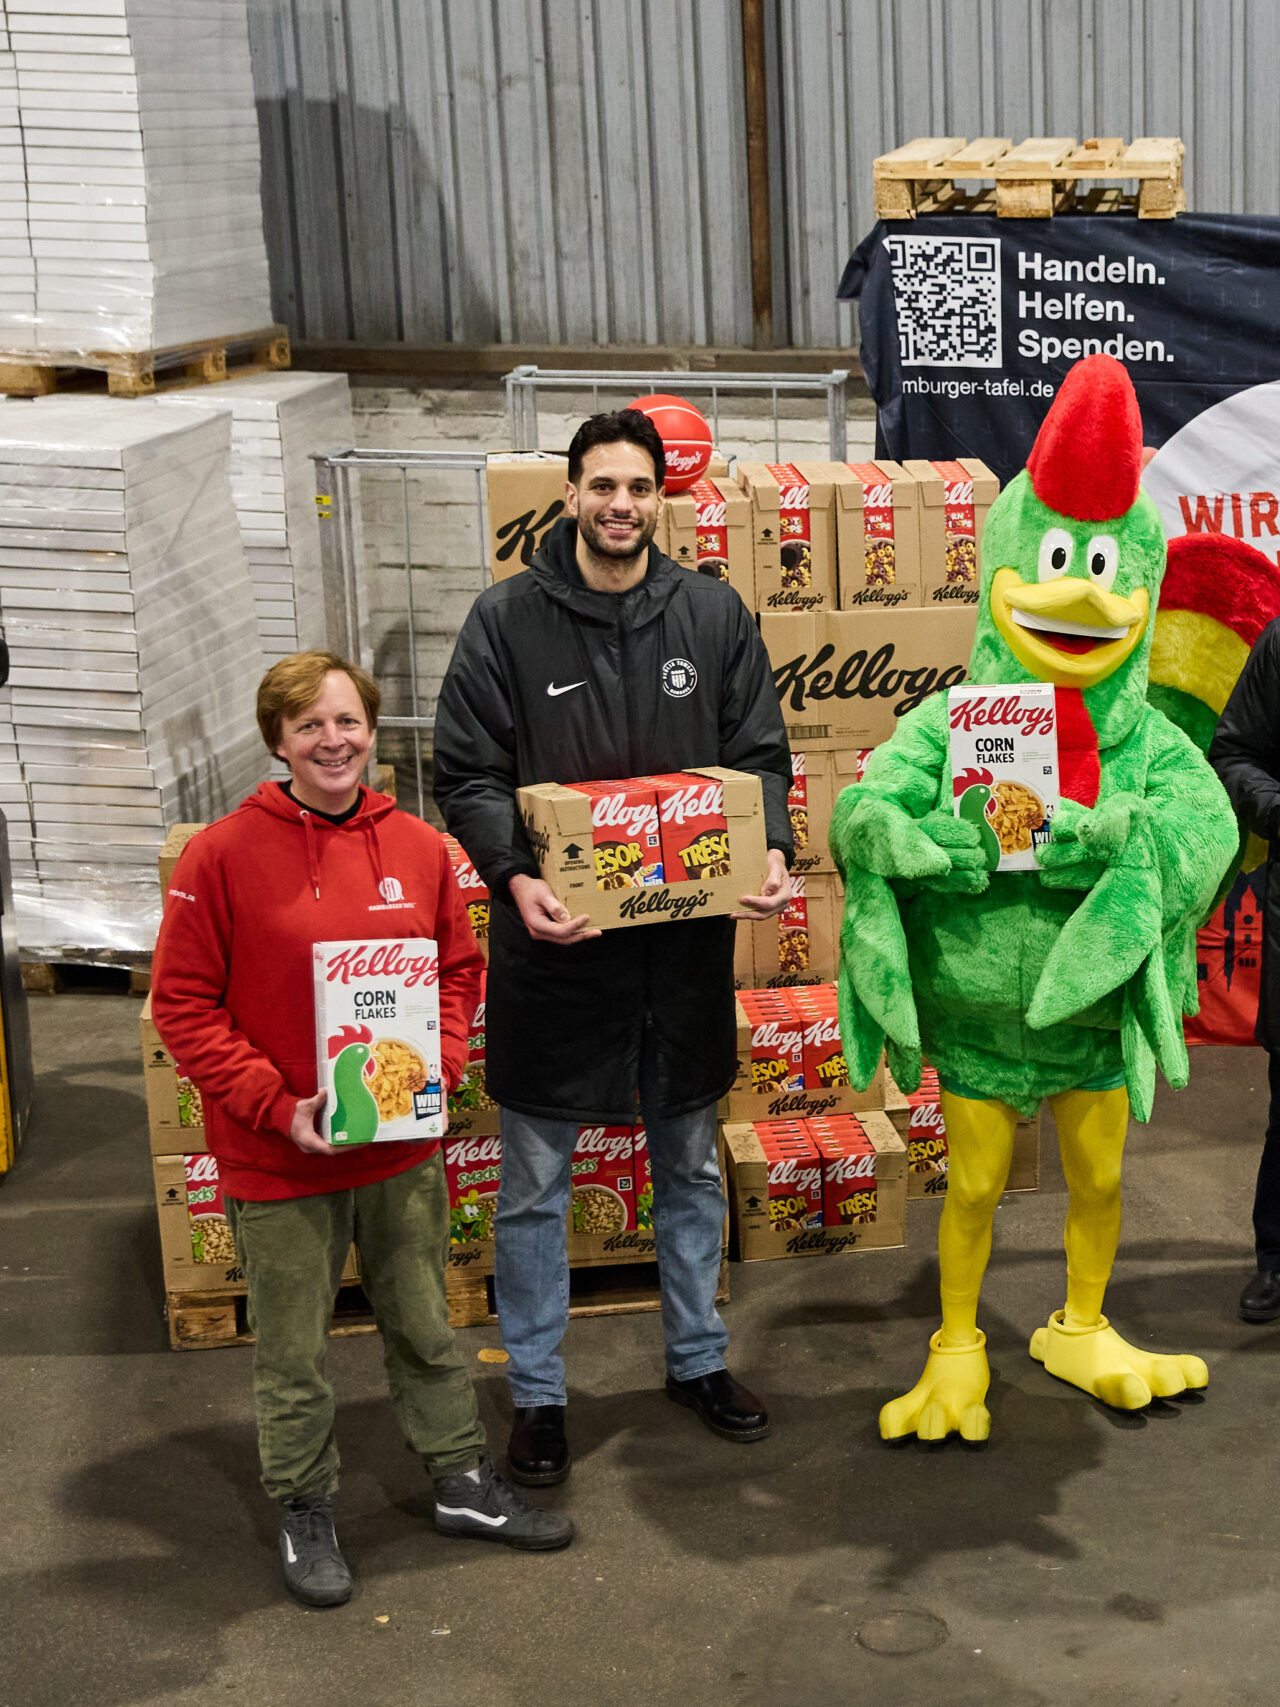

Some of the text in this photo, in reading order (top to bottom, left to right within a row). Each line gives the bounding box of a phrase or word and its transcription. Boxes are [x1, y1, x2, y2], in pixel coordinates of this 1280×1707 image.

[1018, 251, 1166, 285] Handeln.
[1018, 291, 1135, 323] Helfen.
[1018, 329, 1175, 363] Spenden.
[1178, 491, 1280, 538] WIR
[767, 590, 826, 607] Kellogg's
[853, 588, 911, 606] Kellogg's
[975, 738, 1014, 752] CORN
[977, 753, 1014, 763] FLAKES
[619, 889, 709, 920] Kellogg's
[354, 990, 396, 1007] CORN
[355, 1007, 396, 1020] FLAKES
[416, 1094, 440, 1107] WIN
[768, 1094, 839, 1116] Kellogg's
[786, 1231, 857, 1253] Kellogg's
